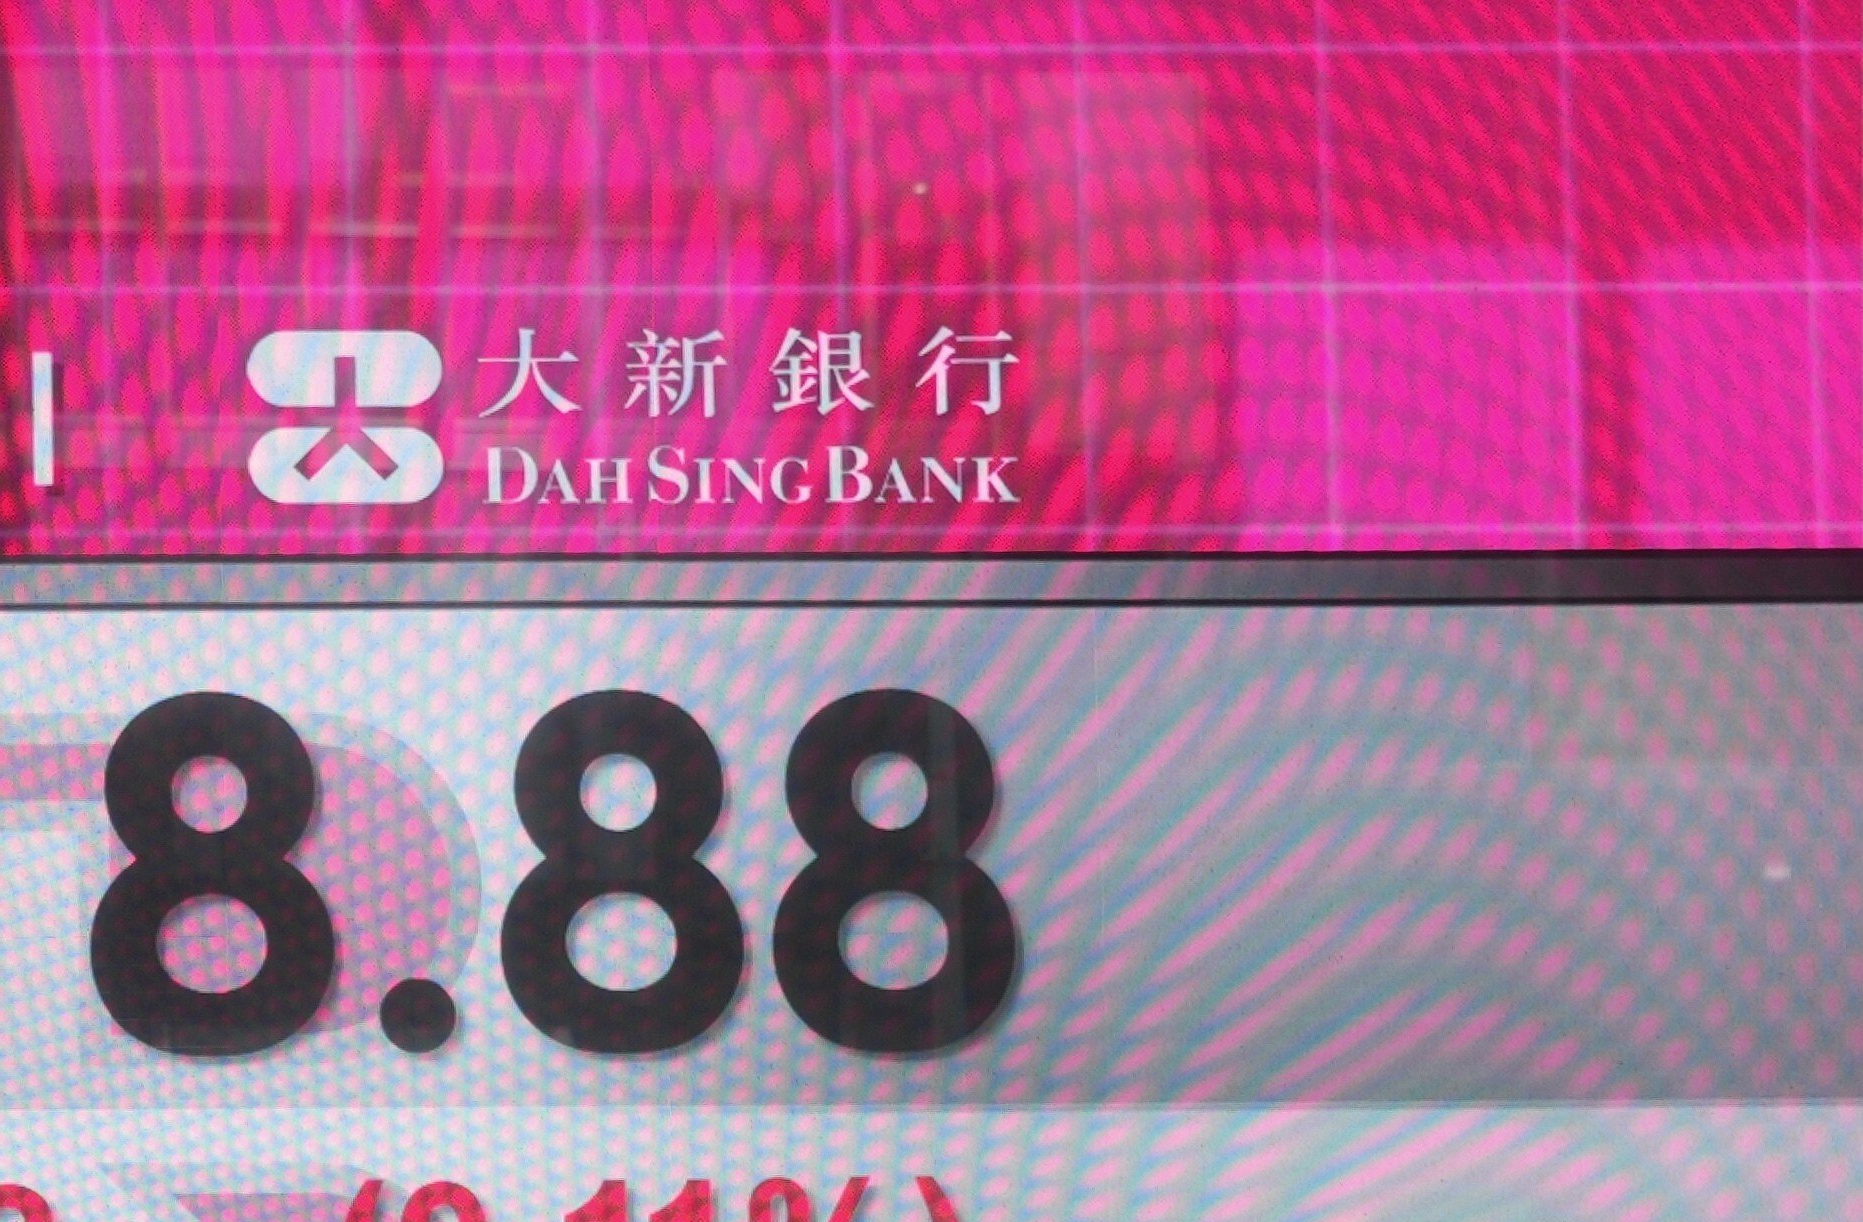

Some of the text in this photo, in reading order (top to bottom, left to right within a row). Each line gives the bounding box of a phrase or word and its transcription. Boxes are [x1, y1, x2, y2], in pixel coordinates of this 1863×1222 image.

[477, 326, 1020, 418] 大新銀行
[482, 444, 1022, 505] DAH SING BANK
